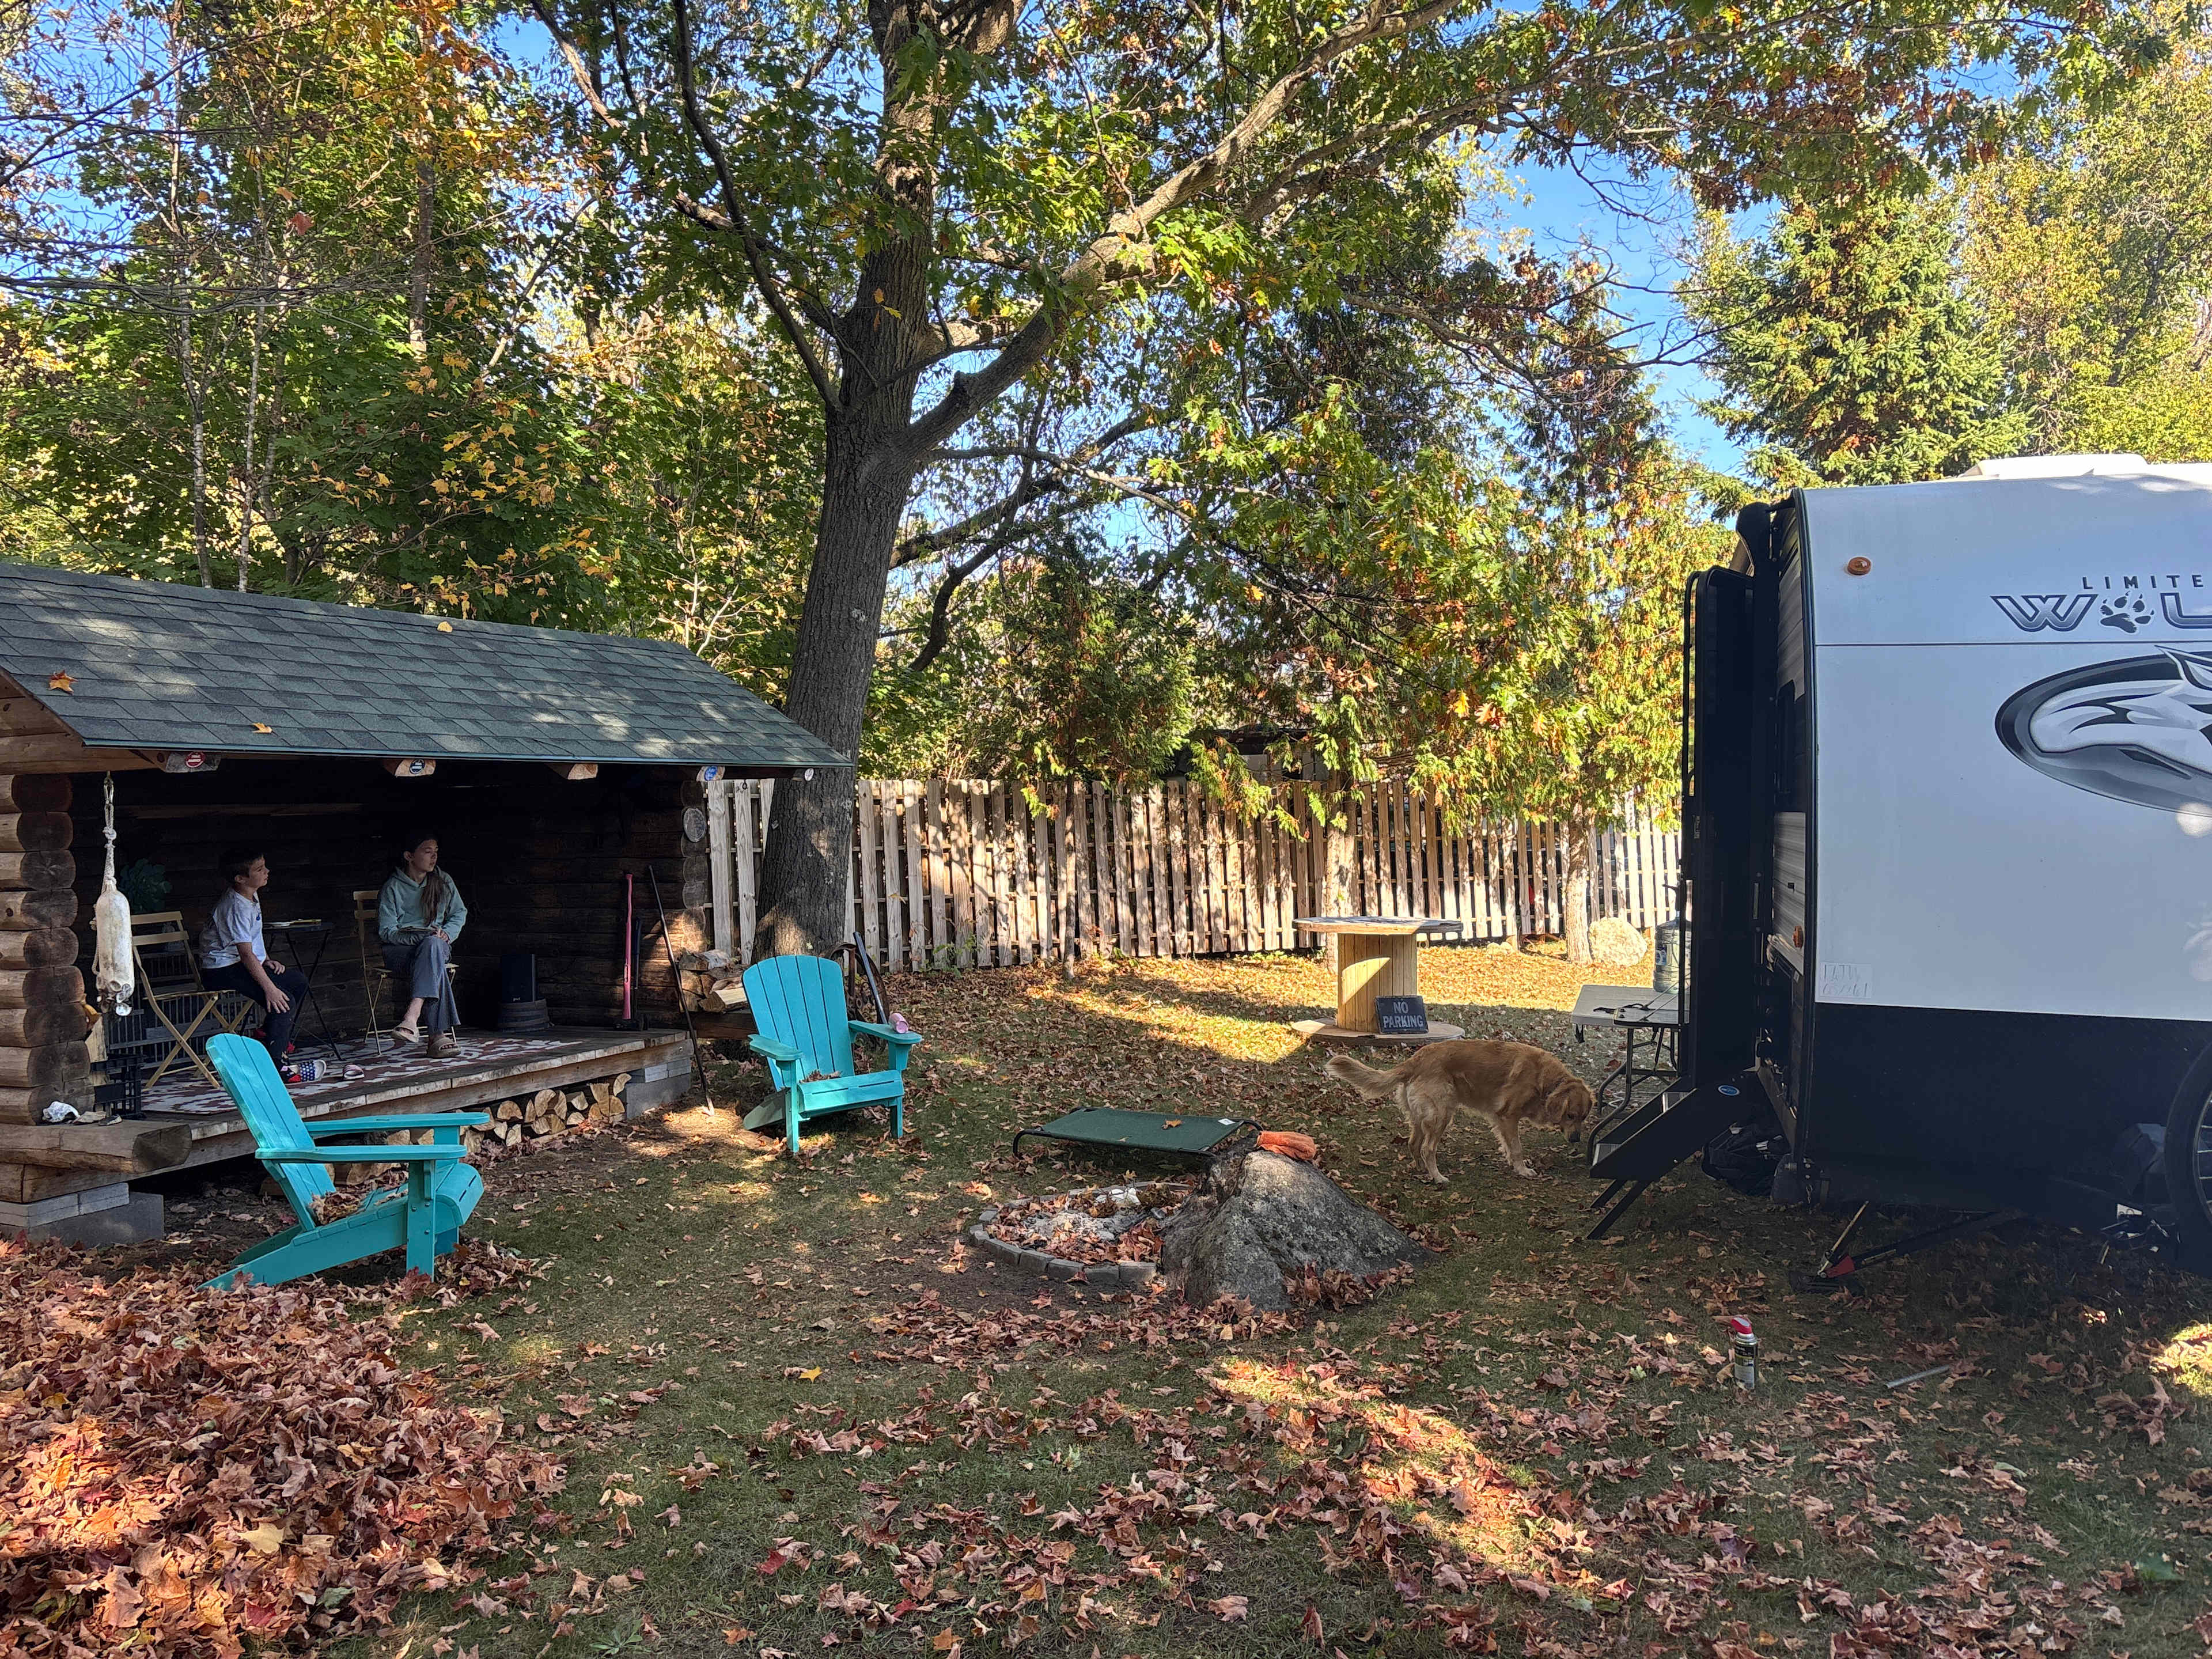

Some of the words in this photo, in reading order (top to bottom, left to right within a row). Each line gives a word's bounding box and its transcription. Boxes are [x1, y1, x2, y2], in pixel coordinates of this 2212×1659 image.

[2082, 574, 2204, 590] LIMITE
[1393, 1001, 1410, 1014] NO
[1382, 1014, 1424, 1028] PARKING
